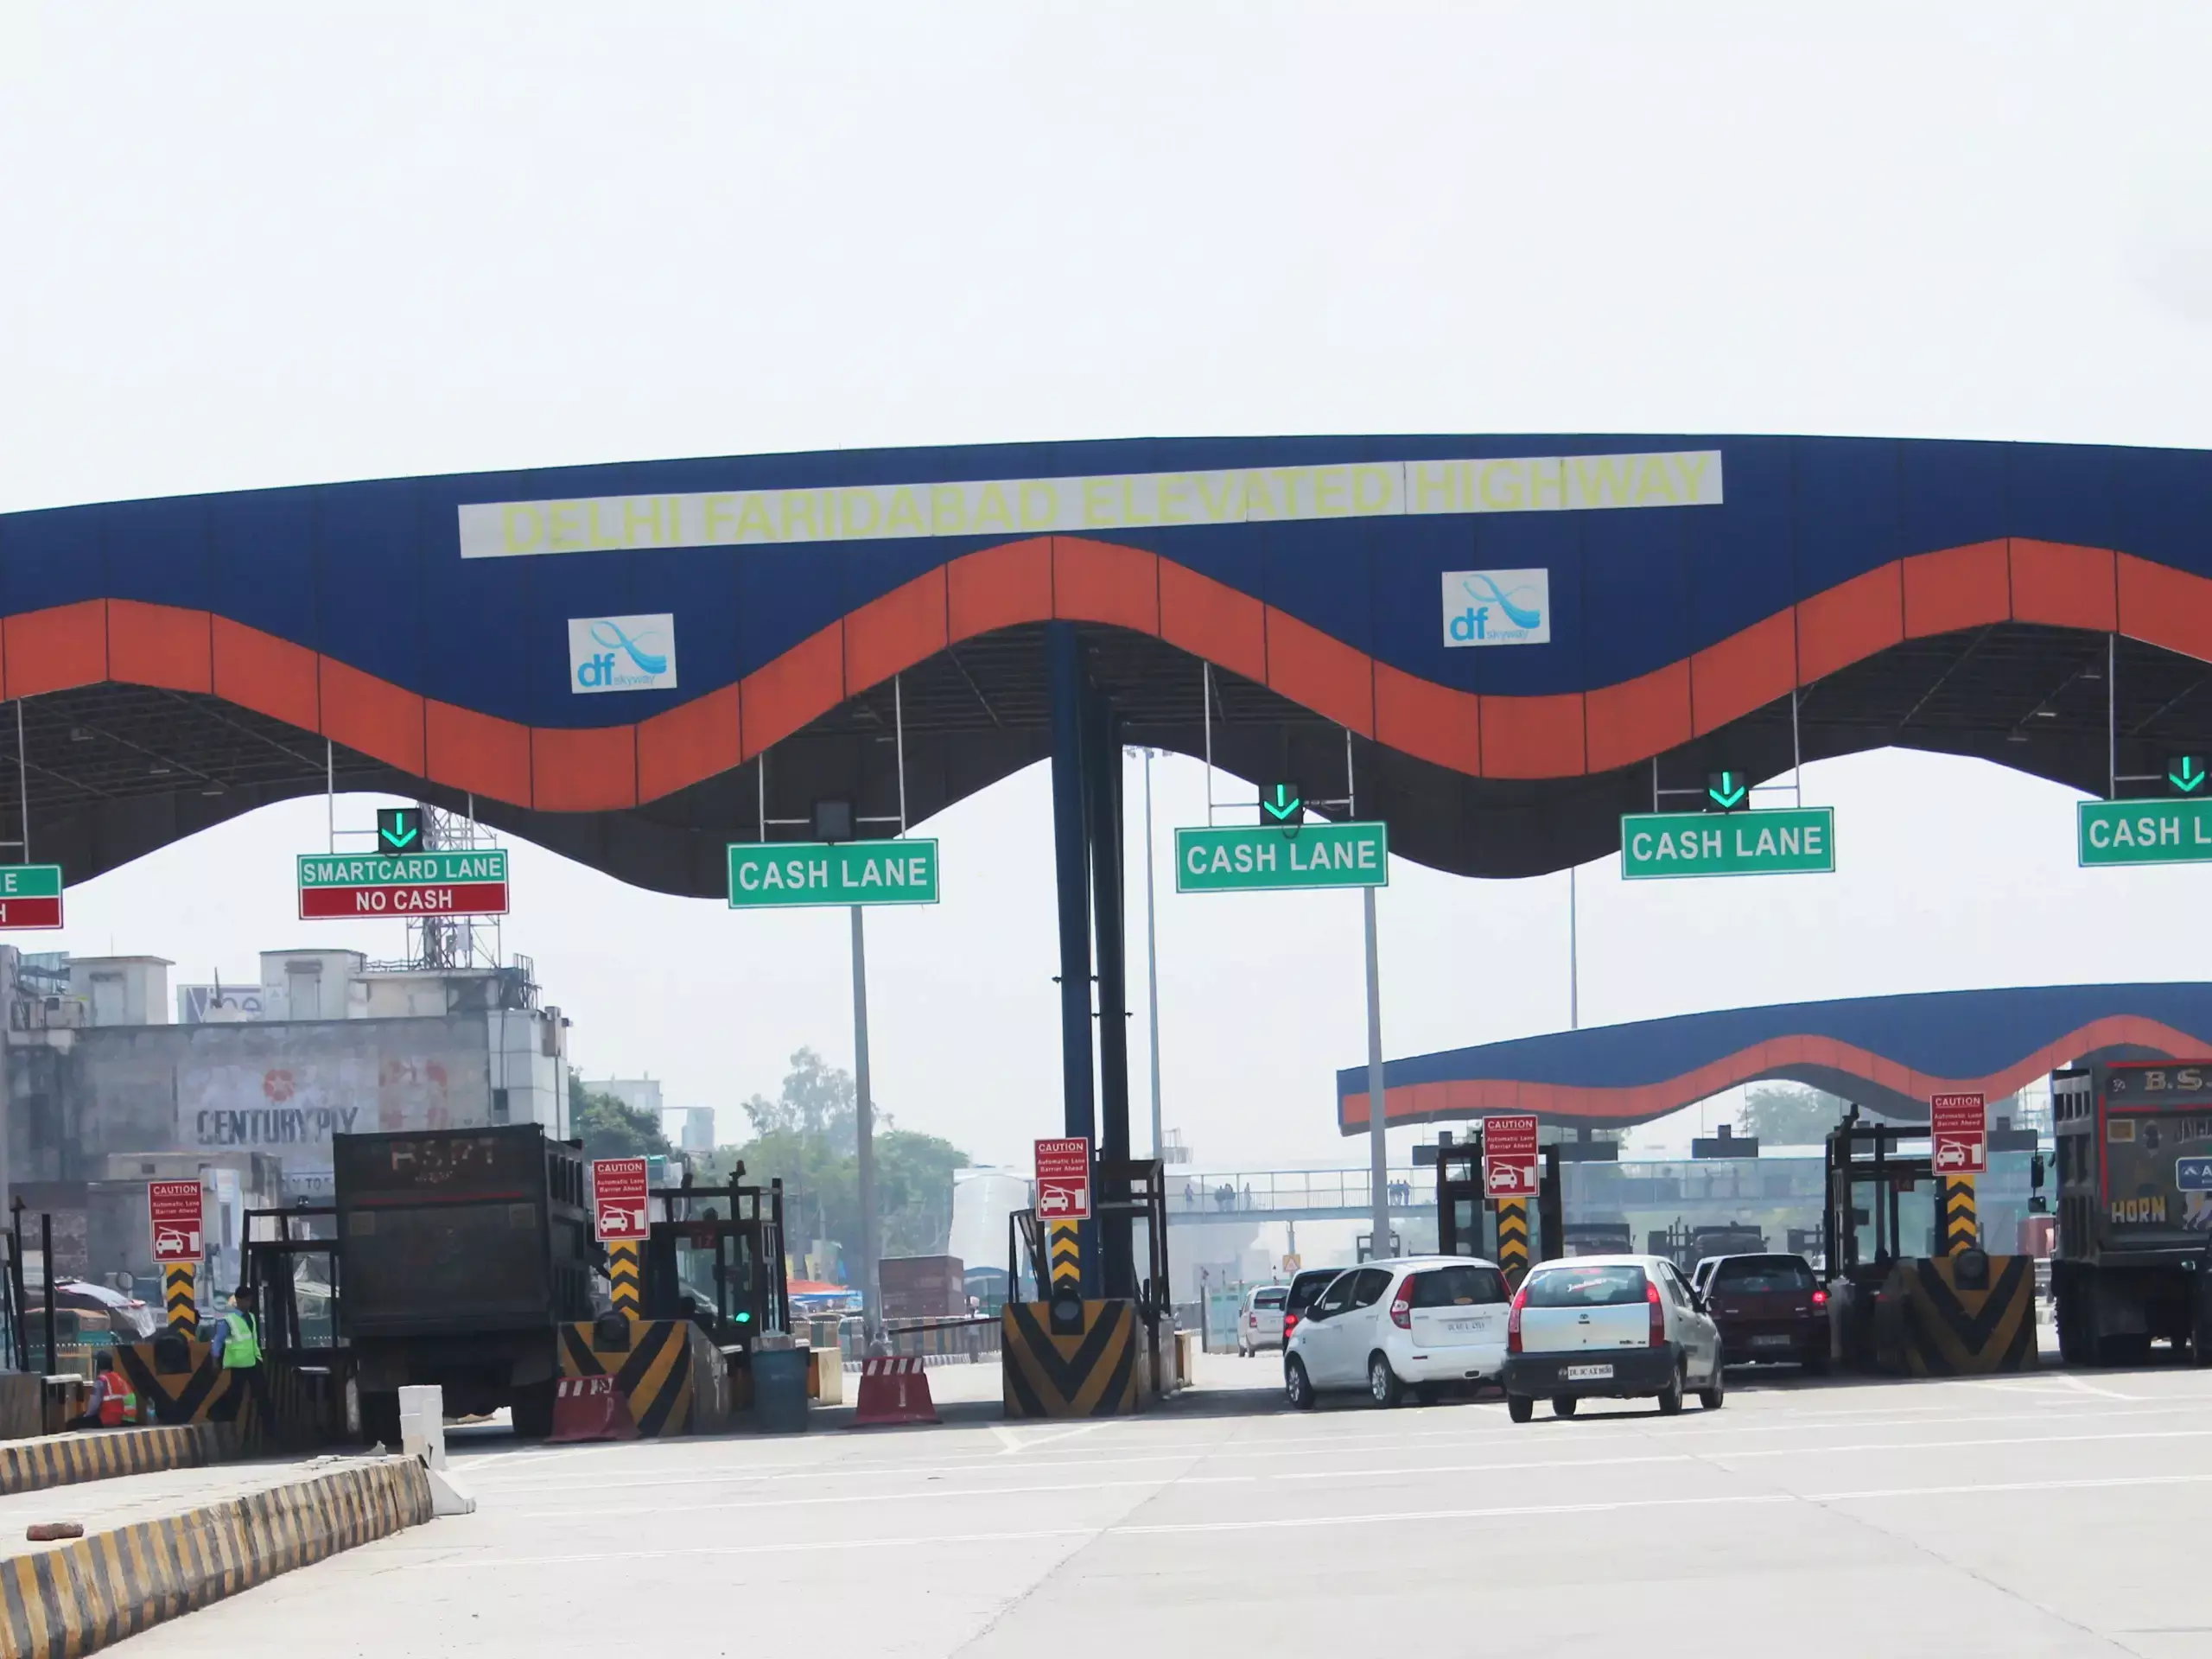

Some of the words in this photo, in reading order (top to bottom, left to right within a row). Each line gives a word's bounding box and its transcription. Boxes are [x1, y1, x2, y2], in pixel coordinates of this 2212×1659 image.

[502, 497, 682, 553] DELHI
[705, 480, 1059, 542] FARIDABAD
[1082, 465, 1394, 527] ELEVATED
[1415, 453, 1709, 511] HIGHWAY
[1450, 607, 1489, 641] df
[577, 653, 615, 688] df
[1632, 830, 1722, 861] CASH
[1736, 826, 1822, 856] LANE
[2089, 817, 2180, 849] CASH
[303, 859, 437, 882] SMARTCARD
[446, 857, 502, 879] LANE
[1187, 843, 1276, 874] CASH
[1290, 840, 1376, 871] LANE
[739, 860, 829, 890] CASH
[842, 857, 927, 887] LANE
[356, 890, 386, 911] NO
[394, 889, 452, 910] CASH
[1936, 1096, 1980, 1106] CAUTION
[1488, 1119, 1533, 1128] CAUTION
[1038, 1142, 1084, 1152] CAUTION
[597, 1163, 643, 1173] CAUTION
[153, 1185, 198, 1195] CAUTION
[2111, 1196, 2165, 1224] HORN
